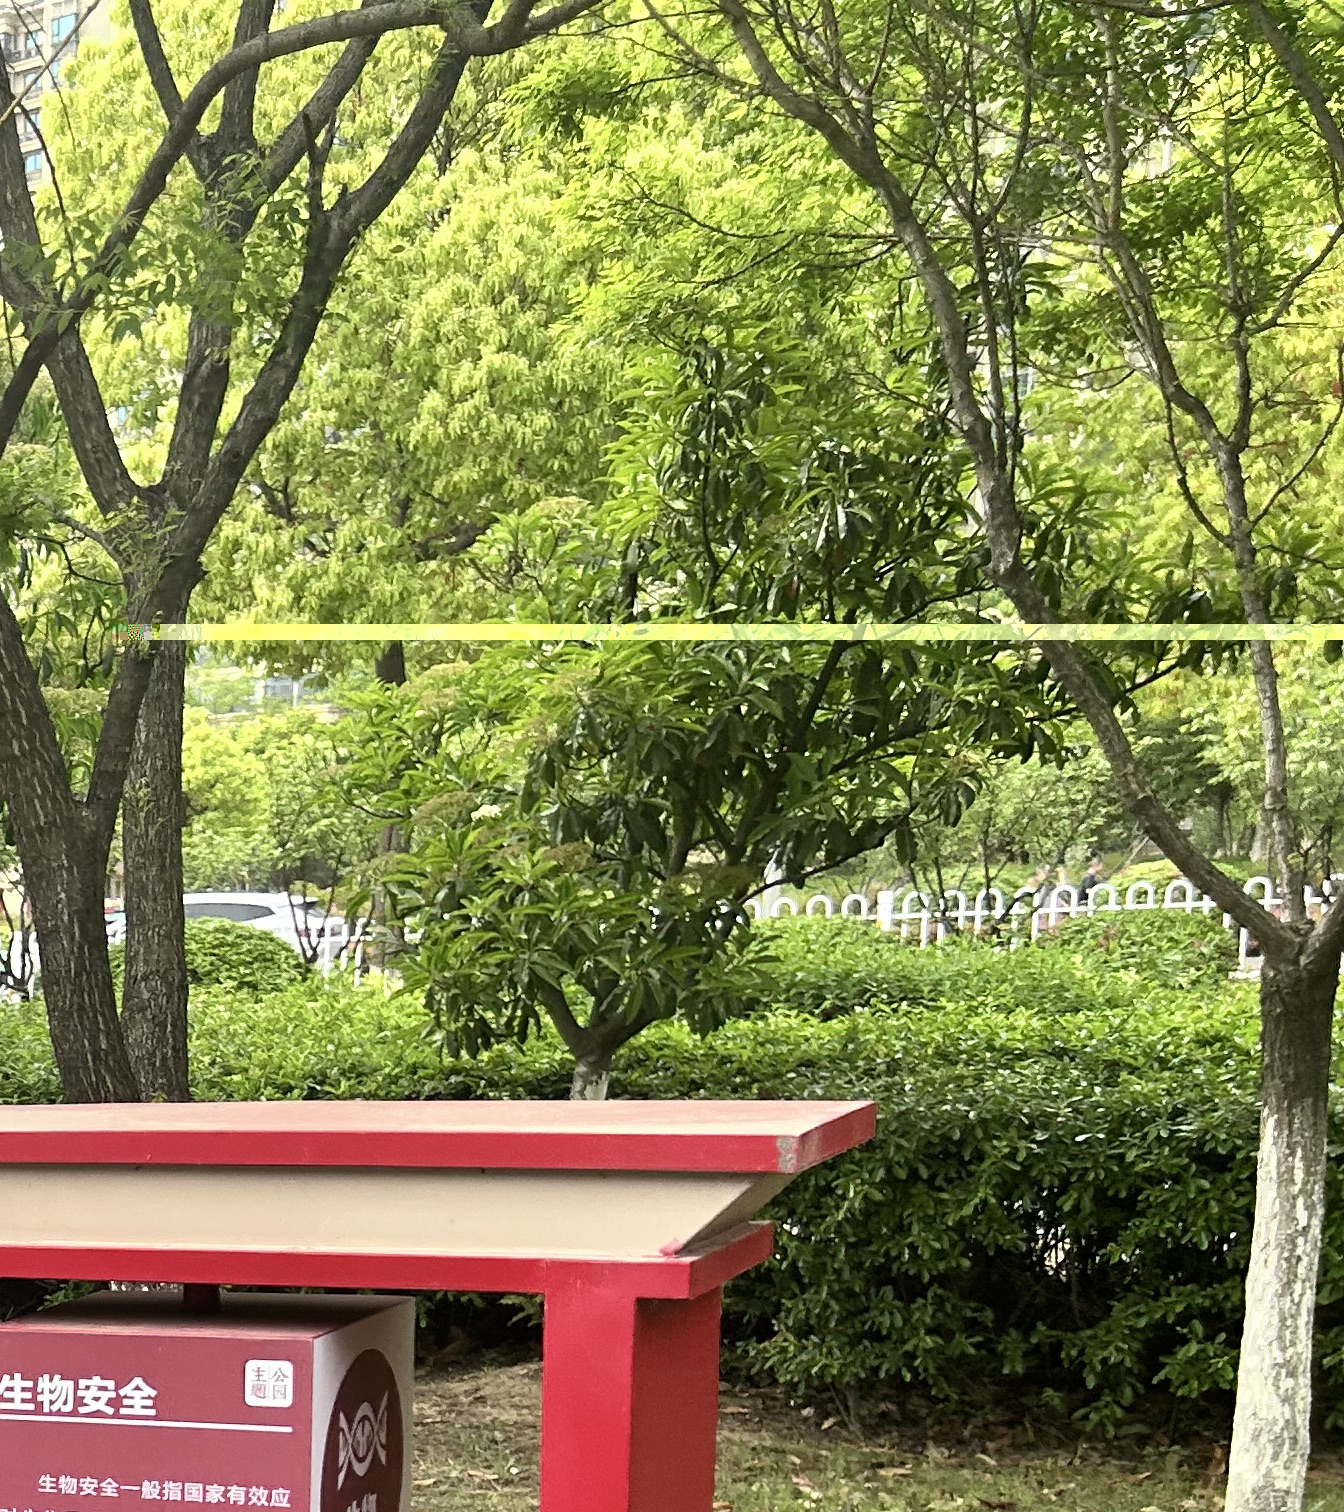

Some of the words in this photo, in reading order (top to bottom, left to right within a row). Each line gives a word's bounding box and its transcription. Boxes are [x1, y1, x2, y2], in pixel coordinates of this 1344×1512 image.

[38, 1474, 291, 1508] 生物安全一般指国家有效应
